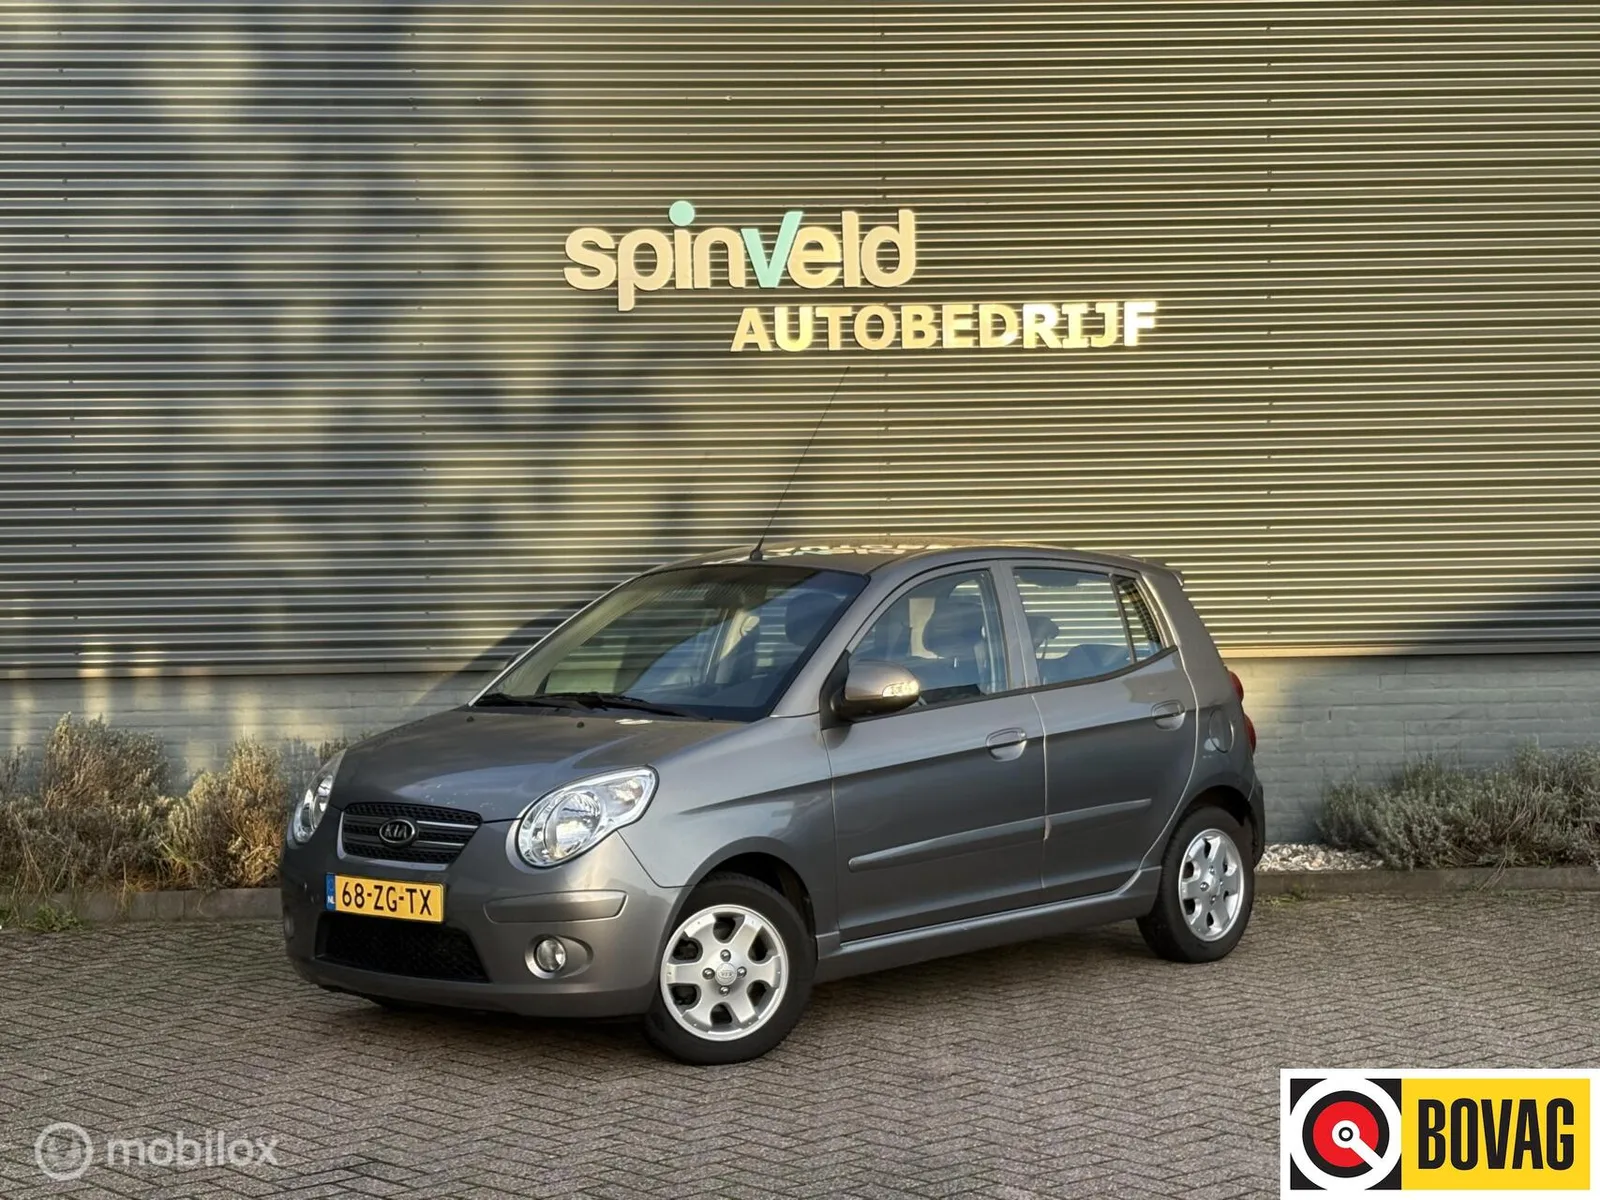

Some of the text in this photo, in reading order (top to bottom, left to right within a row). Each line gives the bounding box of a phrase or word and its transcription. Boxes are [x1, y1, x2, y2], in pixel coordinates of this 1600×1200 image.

[564, 201, 916, 312] spinveld
[731, 300, 1157, 353] AUTOBEDRIJF
[384, 825, 408, 840] KIA
[341, 881, 432, 916] 68-ZG-TX
